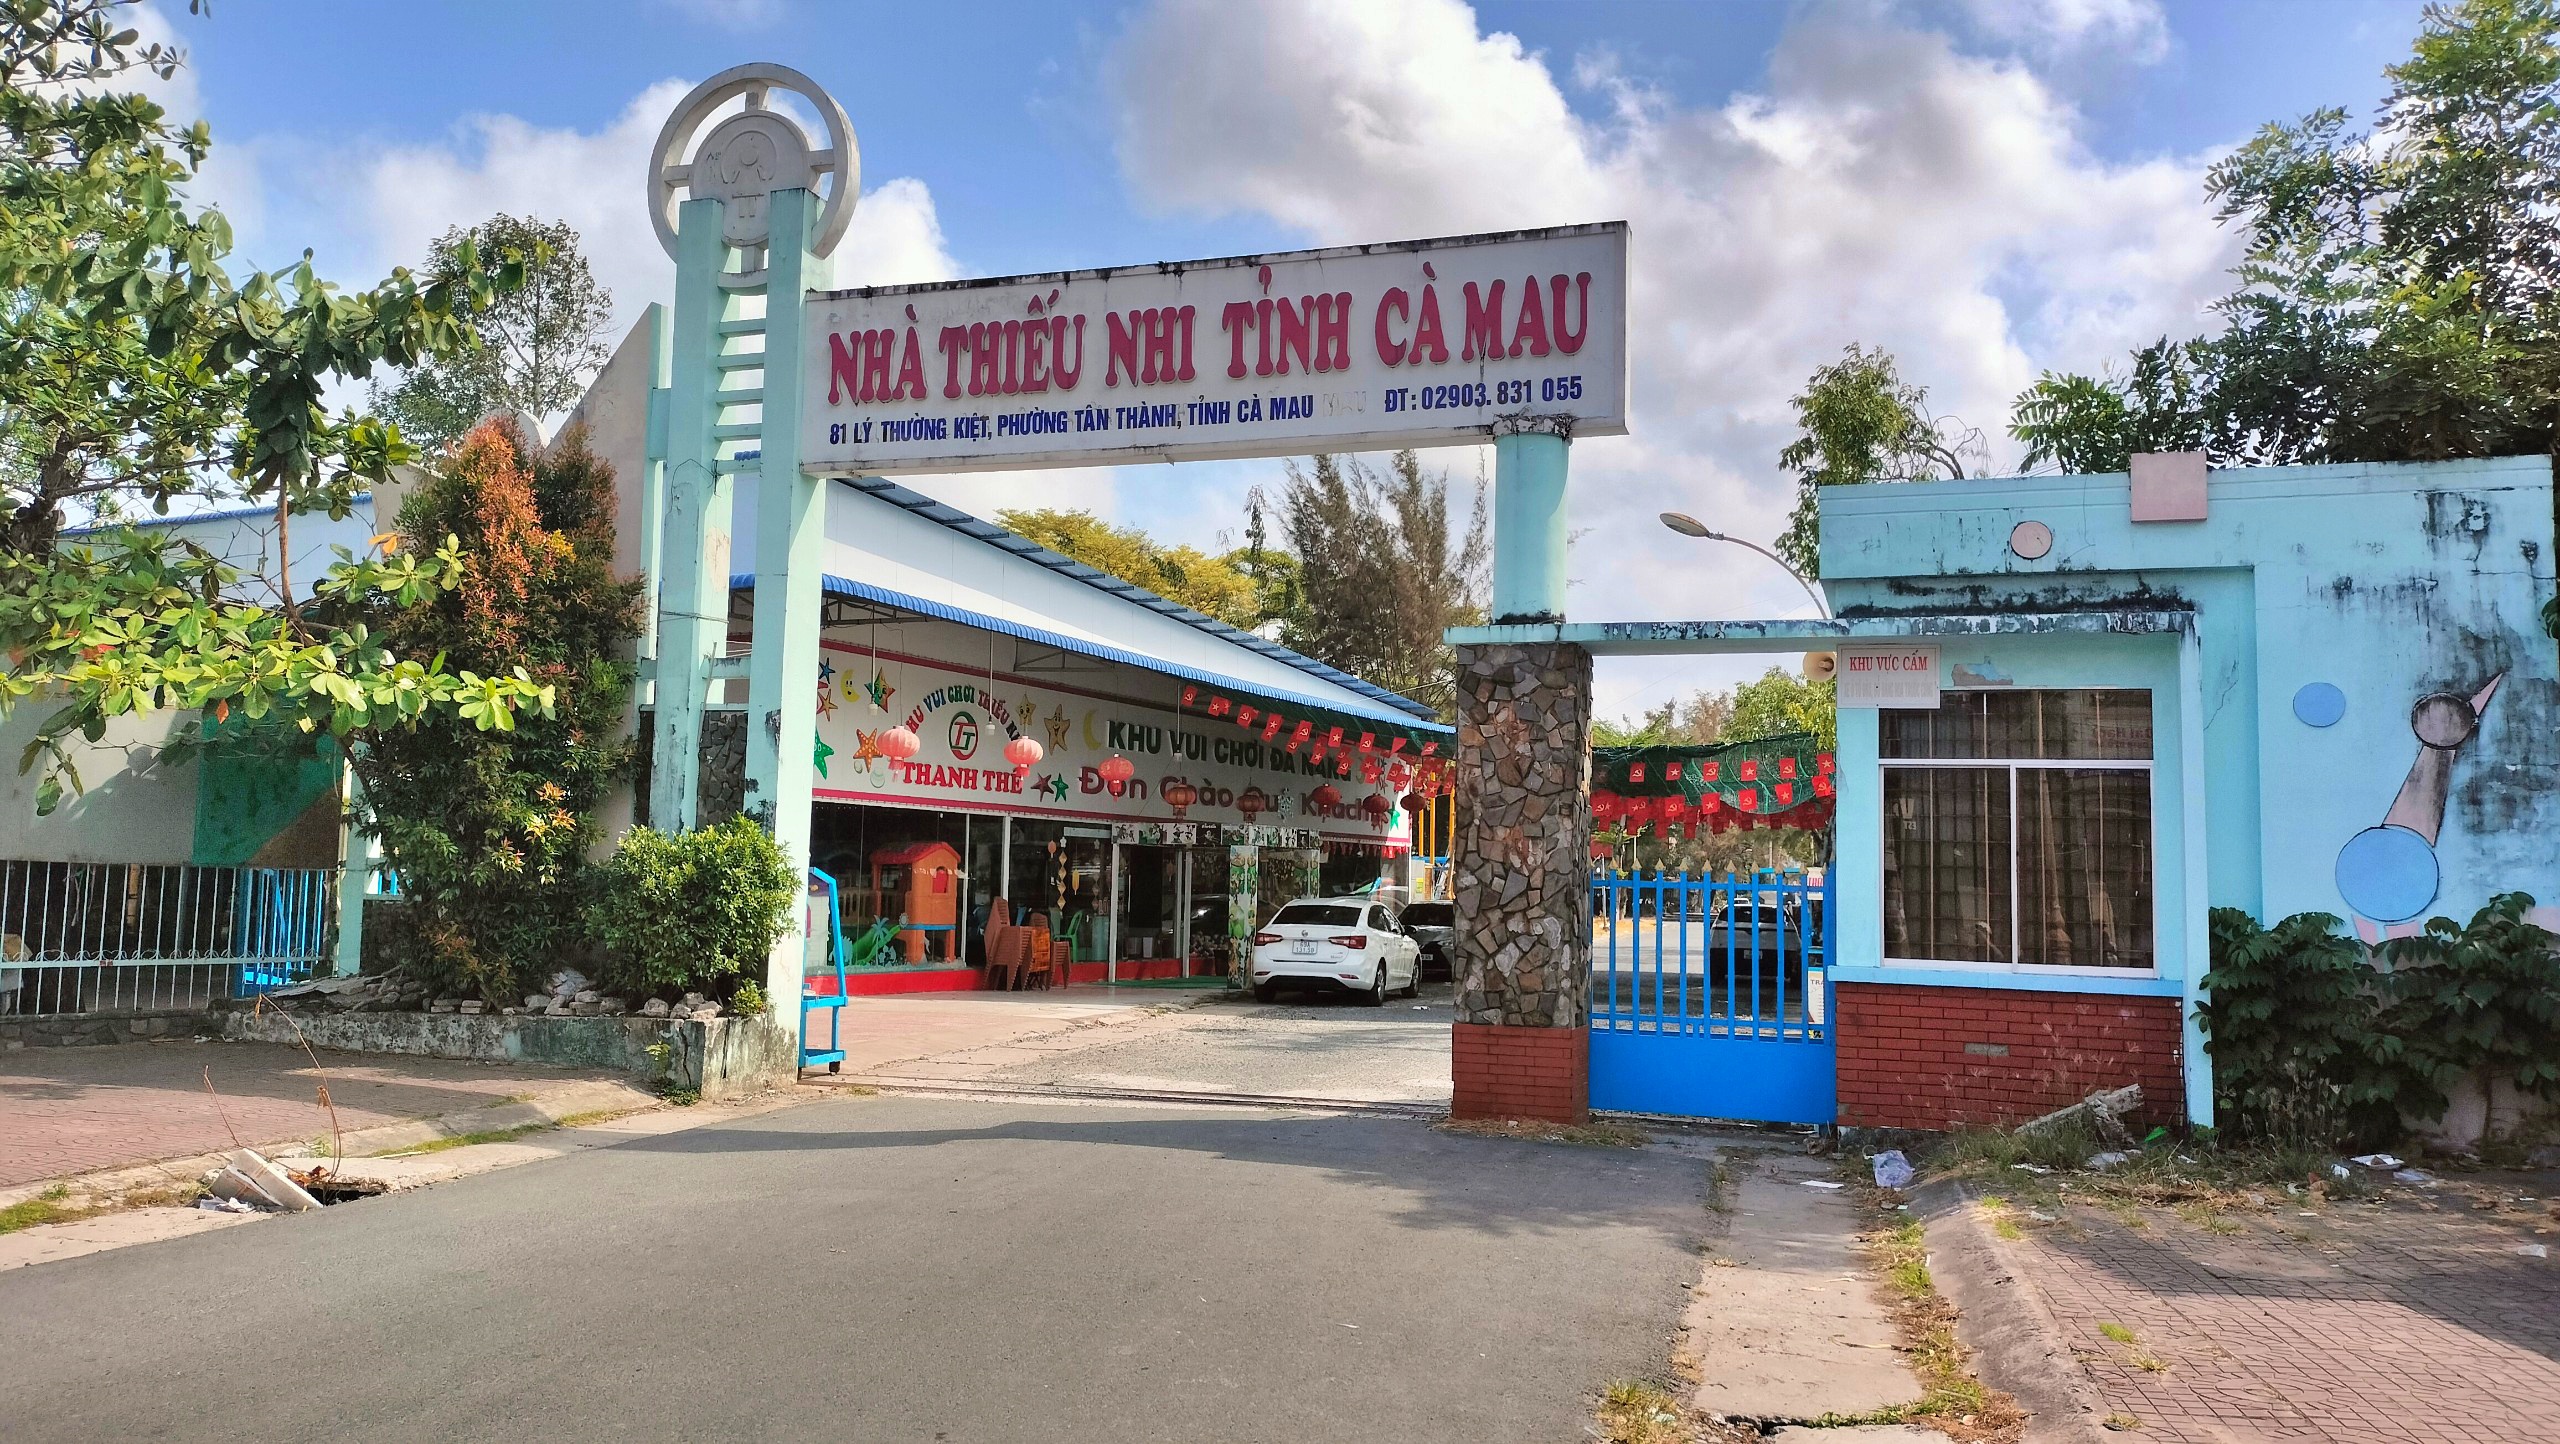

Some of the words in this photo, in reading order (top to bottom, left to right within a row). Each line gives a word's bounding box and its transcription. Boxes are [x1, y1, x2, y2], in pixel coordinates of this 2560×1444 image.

[828, 303, 929, 407] NHÀ
[938, 289, 1087, 399] THIẾU
[1105, 304, 1197, 388] NHI
[1221, 264, 1353, 380] TỈNH
[1374, 261, 1449, 368] CÀ
[1461, 271, 1592, 364] MAU
[1497, 379, 1532, 405] 831
[1541, 375, 1582, 401] 055
[829, 423, 847, 445] 81
[853, 416, 873, 444] LÝ
[881, 413, 947, 442] THƯỜNG
[953, 413, 993, 442] KIỆT,
[997, 407, 1068, 437] PHƯỜNG
[1074, 404, 1109, 432] TÂN
[1116, 401, 1182, 429] THÀNH,
[1187, 394, 1231, 426] TỈNH
[1237, 393, 1263, 423] CÀ
[1269, 394, 1314, 421] MAU
[1849, 656, 1873, 671] KHU
[1903, 649, 1929, 671] CẤM
[923, 688, 946, 713] VUI
[1107, 720, 1161, 754] KHU
[1168, 729, 1207, 761] VUI
[903, 761, 979, 790] THANH
